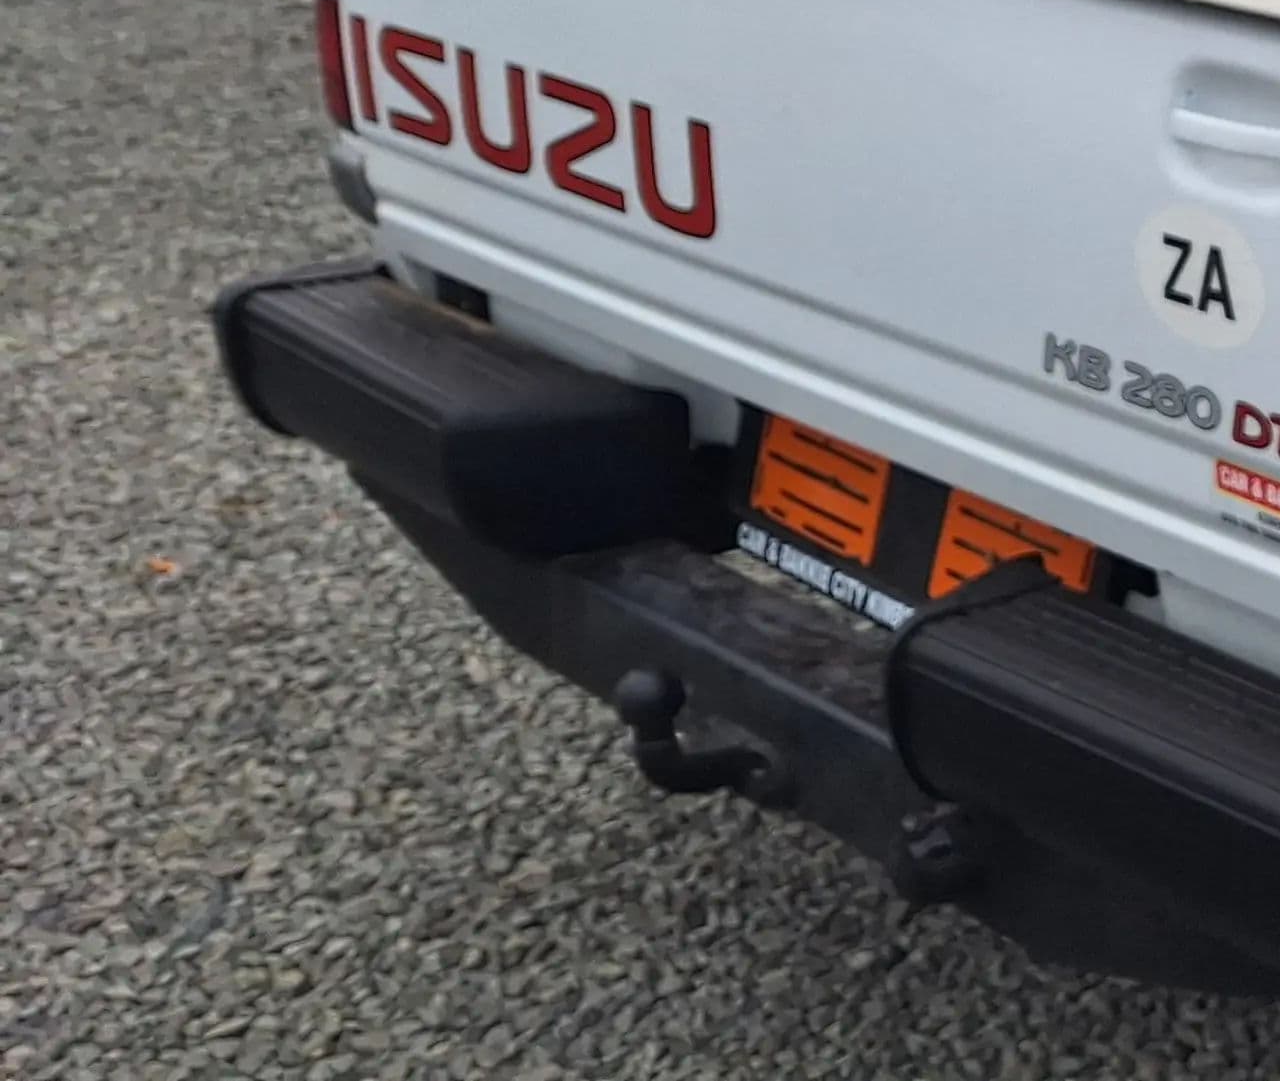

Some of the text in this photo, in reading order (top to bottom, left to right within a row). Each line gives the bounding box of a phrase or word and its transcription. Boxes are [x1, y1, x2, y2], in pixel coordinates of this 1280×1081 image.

[348, 14, 716, 239] ISUZU
[1162, 233, 1237, 321] ZA
[1043, 332, 1111, 391] KB
[1121, 360, 1222, 430] 280
[1218, 464, 1249, 495] CAR
